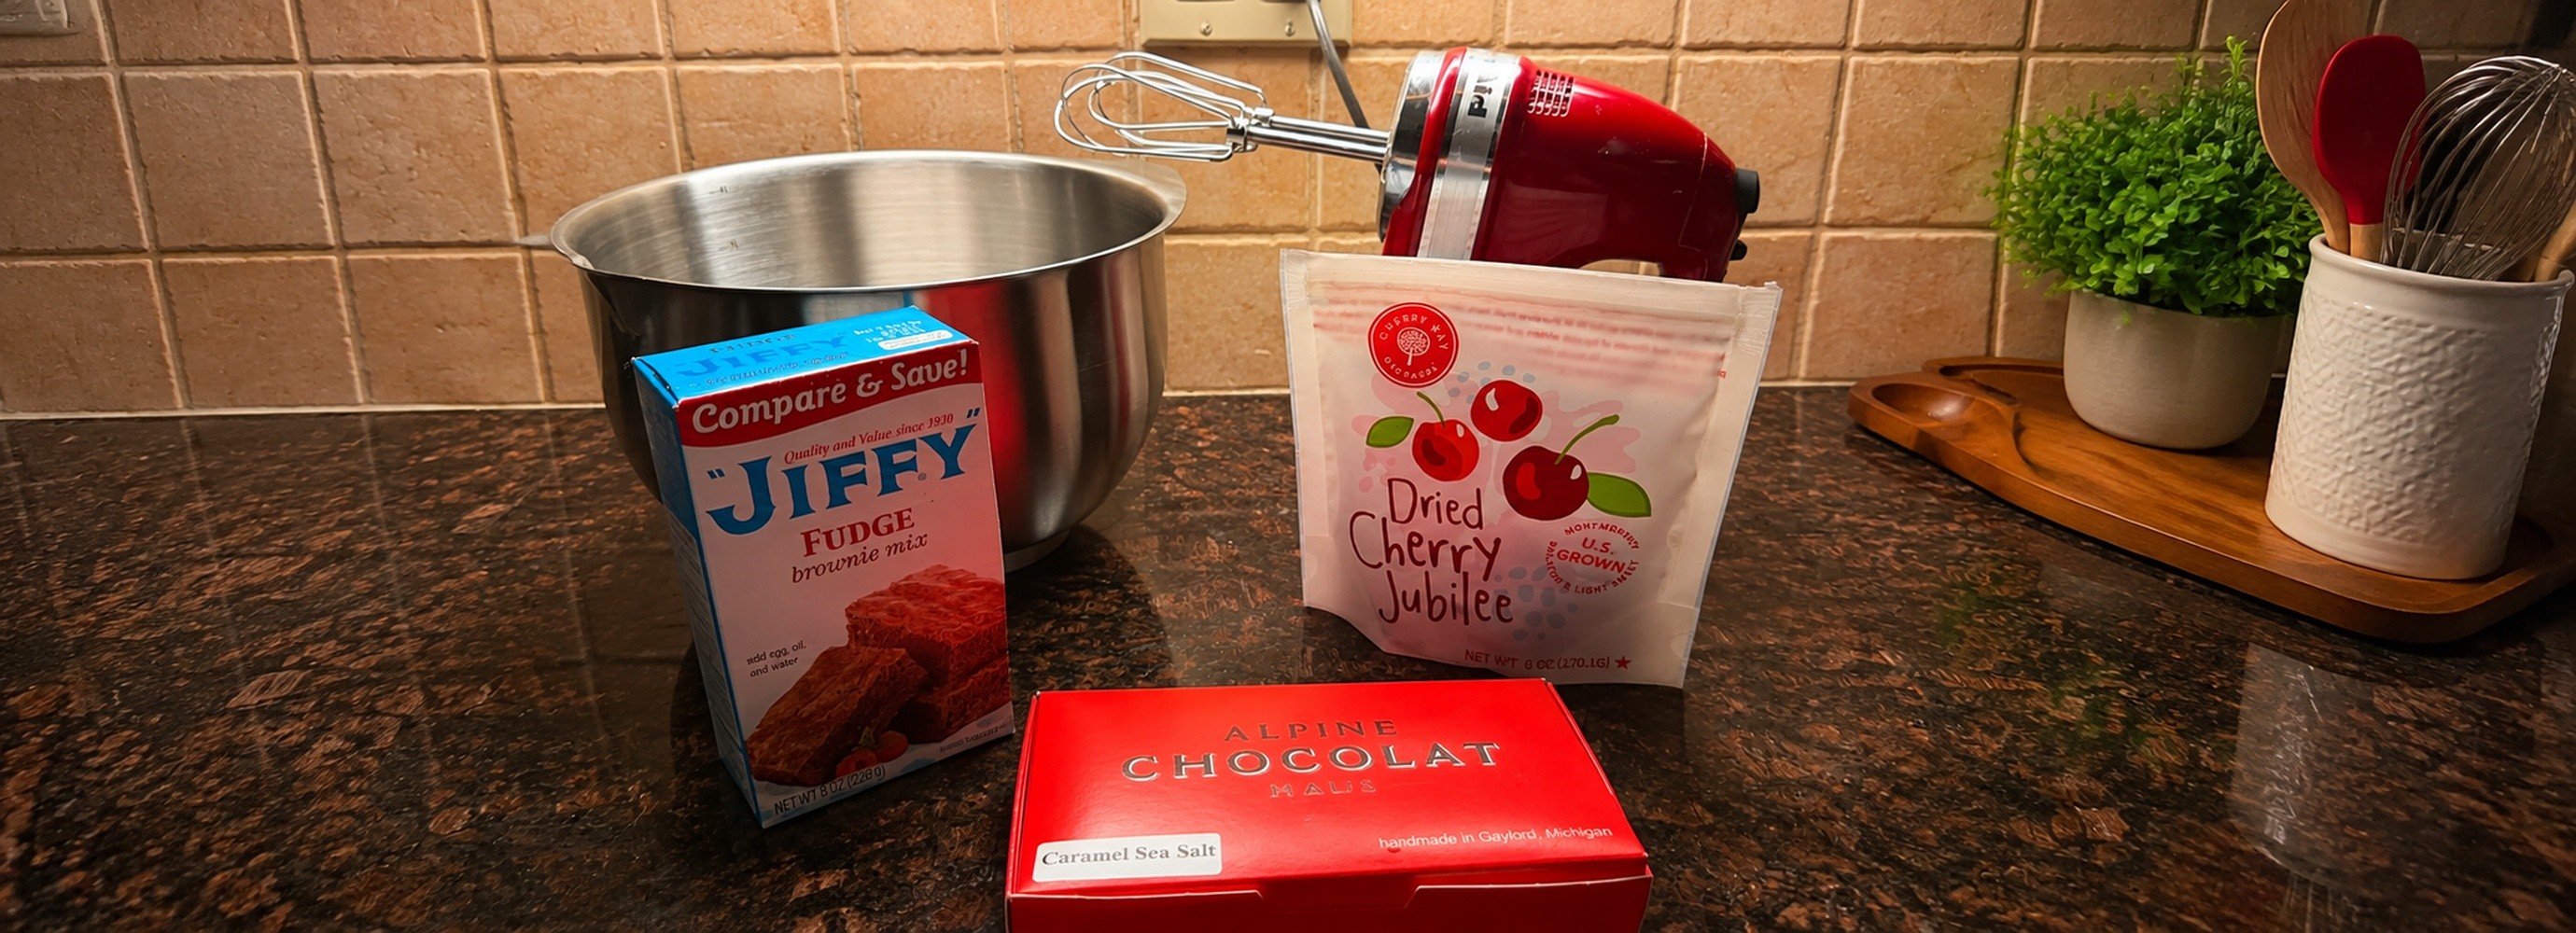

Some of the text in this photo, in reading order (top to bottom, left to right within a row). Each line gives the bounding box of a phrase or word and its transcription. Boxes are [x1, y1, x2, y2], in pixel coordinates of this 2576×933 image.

[693, 381, 847, 434] Compare
[856, 372, 883, 398] &
[891, 348, 968, 391] Save!
[784, 443, 830, 465] Quality
[833, 436, 856, 452] and
[859, 429, 891, 444] Value
[896, 423, 924, 437] since
[1387, 478, 1484, 530] Dried
[801, 508, 916, 557] FUDGE
[1350, 511, 1502, 581] Cherry
[1581, 536, 1615, 555] U.S.
[791, 533, 928, 583] brownie mix
[1557, 550, 1625, 574] GROWN
[1379, 570, 1513, 625] Jubilee
[1575, 584, 1607, 594] LIGHT
[747, 651, 766, 665] add
[749, 657, 798, 677] and water
[1464, 649, 1491, 663] NET
[1224, 720, 1398, 742] ALPINE
[1122, 742, 1500, 782] CHOCOLAT
[774, 795, 800, 815] NET
[798, 789, 817, 804] WT
[830, 778, 847, 794] OZ
[1379, 833, 1457, 849] handmade
[1461, 831, 1475, 844] in
[1545, 827, 1613, 839] Michigan
[1043, 843, 1216, 866] Caramel Sea Salt
